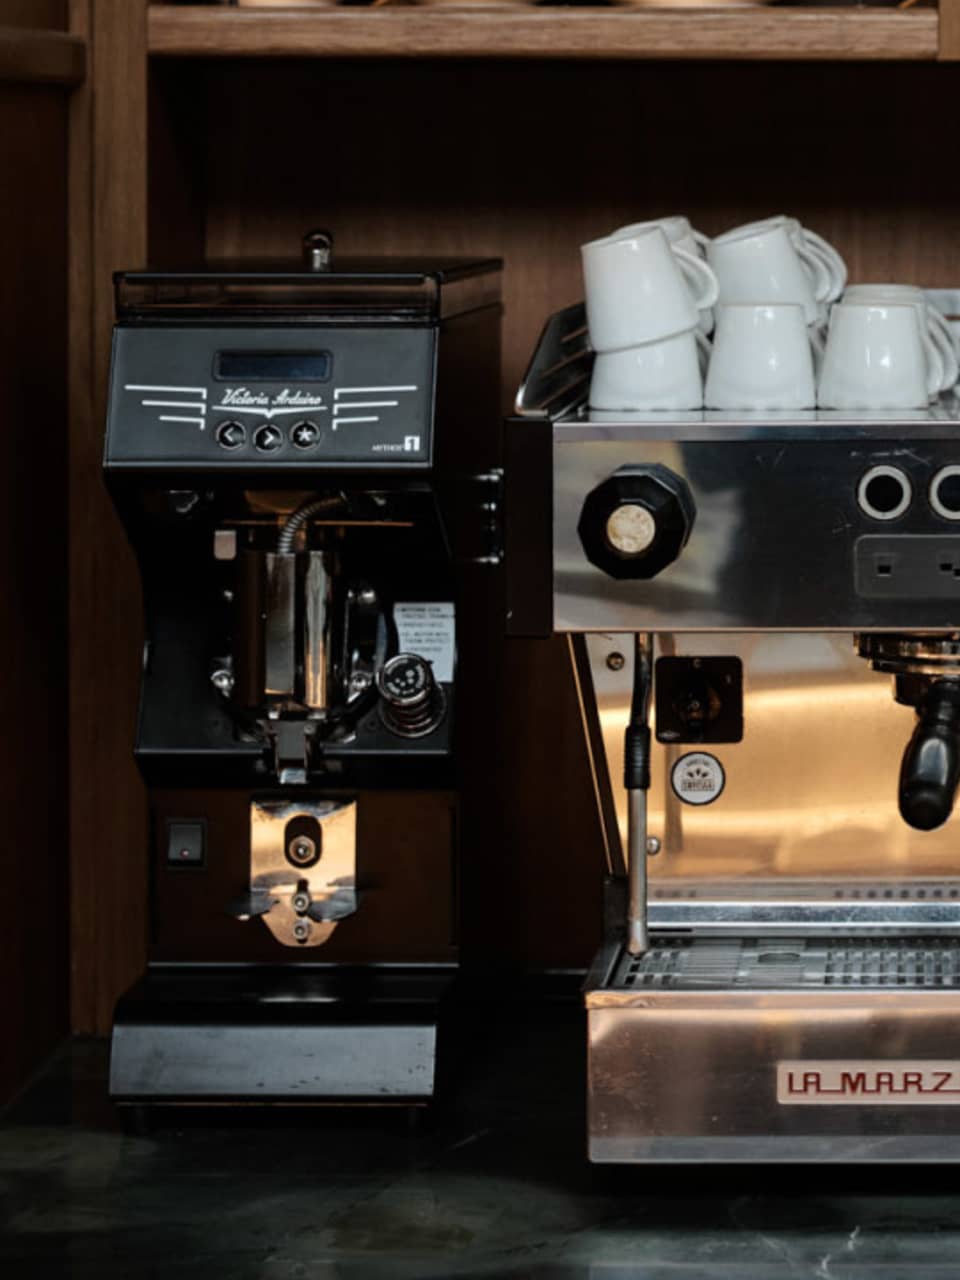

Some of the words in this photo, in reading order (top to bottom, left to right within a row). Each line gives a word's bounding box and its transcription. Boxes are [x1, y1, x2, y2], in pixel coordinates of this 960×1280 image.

[221, 387, 269, 405] Victoria
[271, 388, 322, 405] Arduino
[787, 1071, 821, 1094] LA
